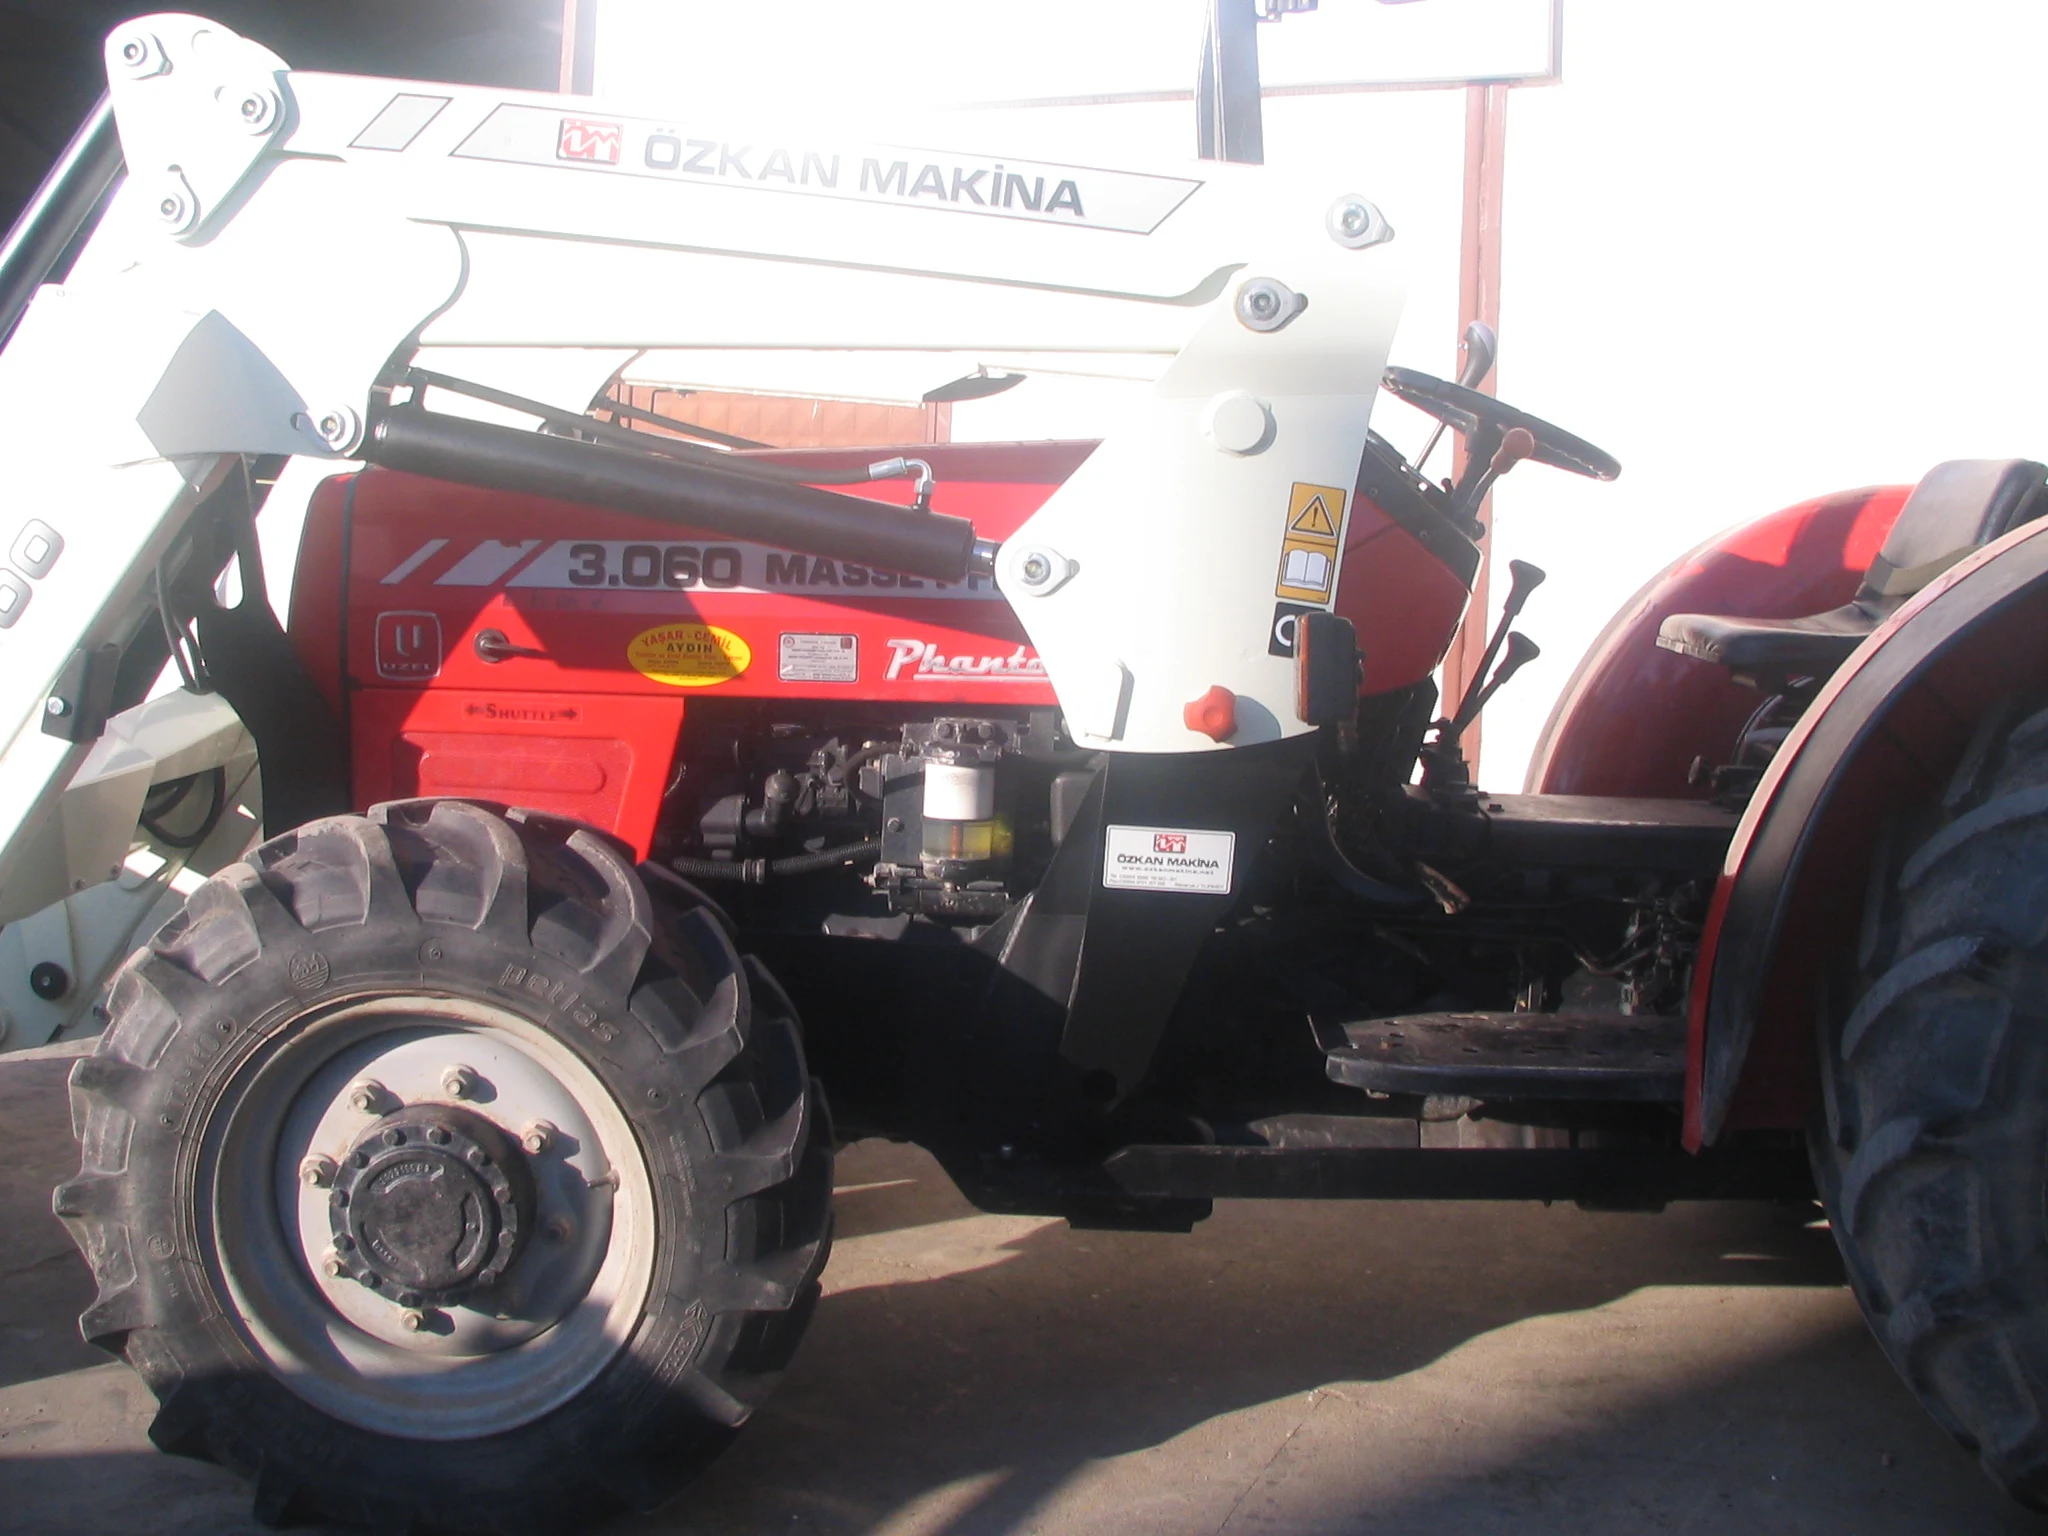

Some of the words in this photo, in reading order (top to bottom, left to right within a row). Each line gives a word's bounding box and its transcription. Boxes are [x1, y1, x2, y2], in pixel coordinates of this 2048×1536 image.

[643, 127, 840, 189] ÖZKAN
[859, 156, 1086, 217] MAKİNA
[569, 543, 743, 589] 3.060
[883, 638, 1047, 681] Phanto
[1117, 853, 1163, 866] ÖZKAN
[1166, 857, 1219, 869] MAKİNA
[499, 962, 621, 1042] petlas
